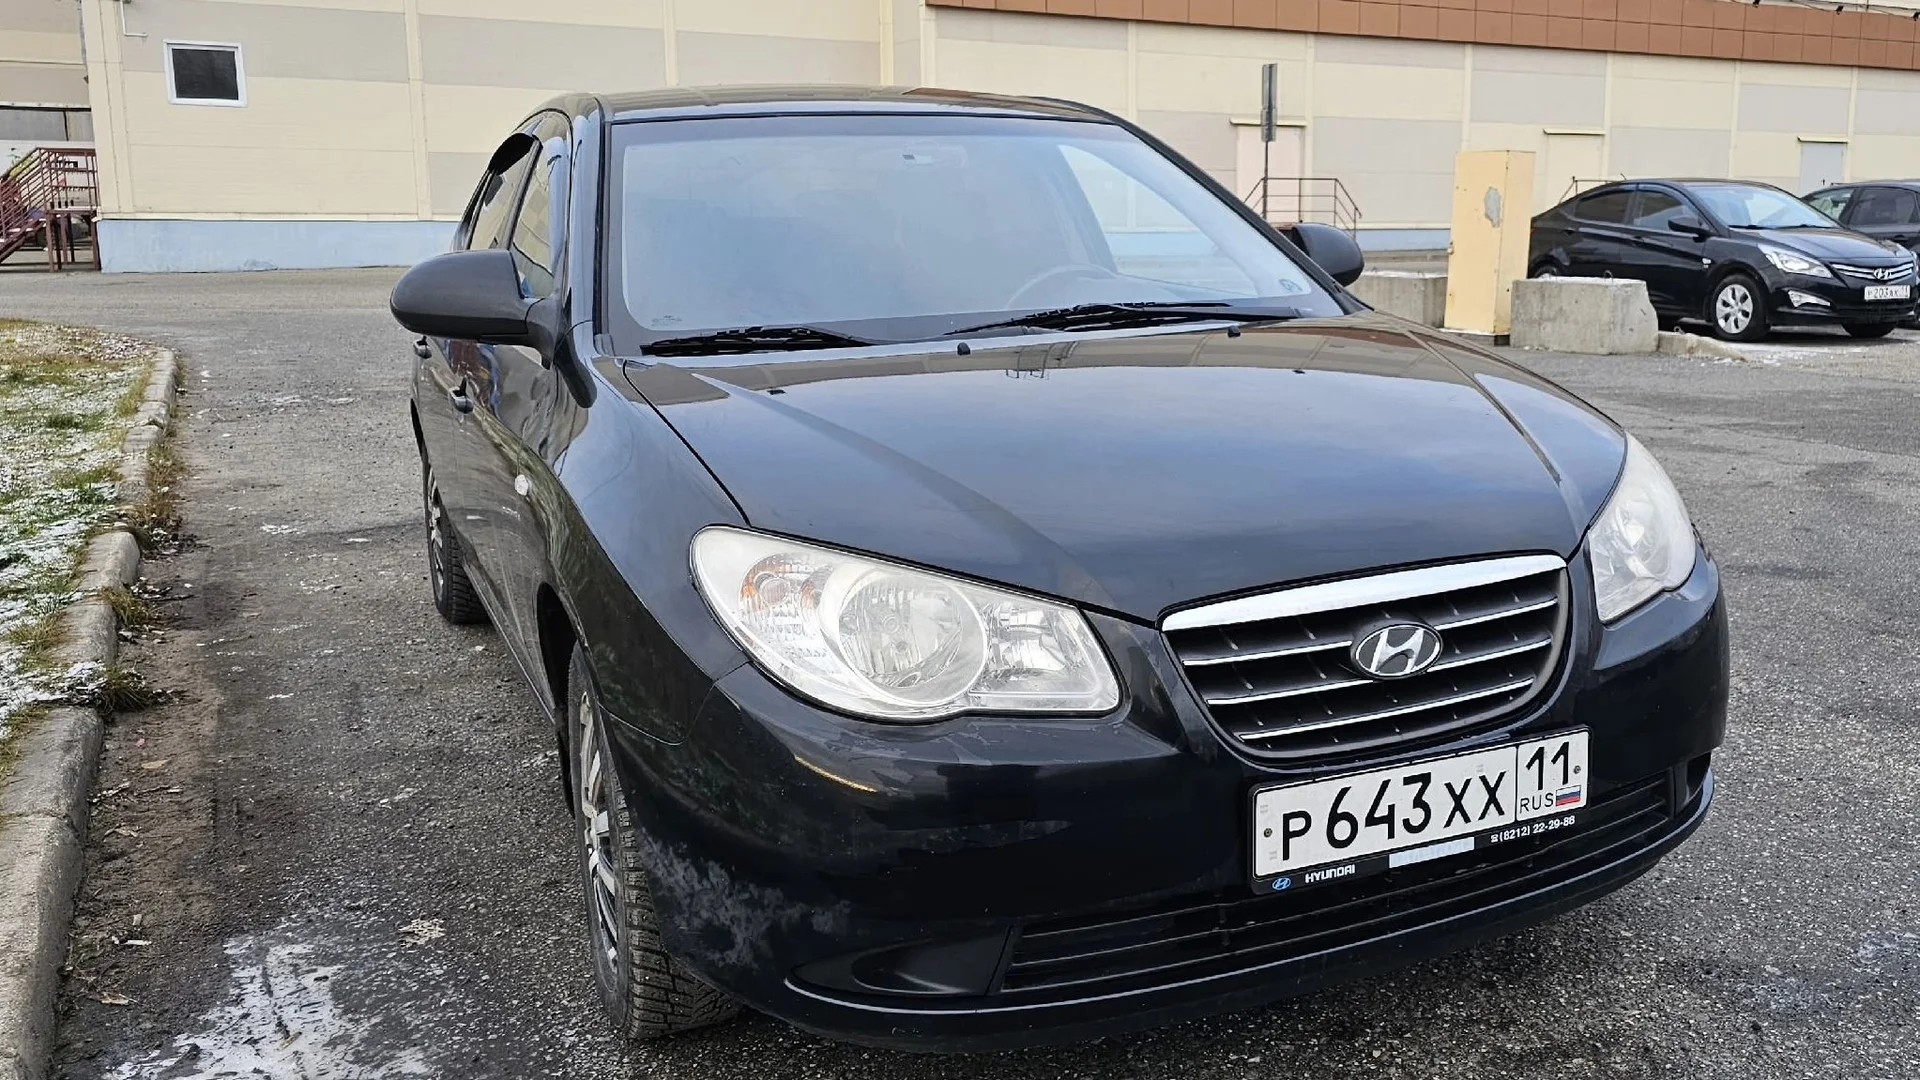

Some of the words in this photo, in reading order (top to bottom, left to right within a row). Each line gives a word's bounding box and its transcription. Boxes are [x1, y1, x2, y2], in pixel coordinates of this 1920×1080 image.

[1525, 741, 1569, 791] 11
[1519, 792, 1554, 814] RUS
[1500, 825, 1530, 842] (8212)
[1305, 864, 1355, 883] HYUNDAI
